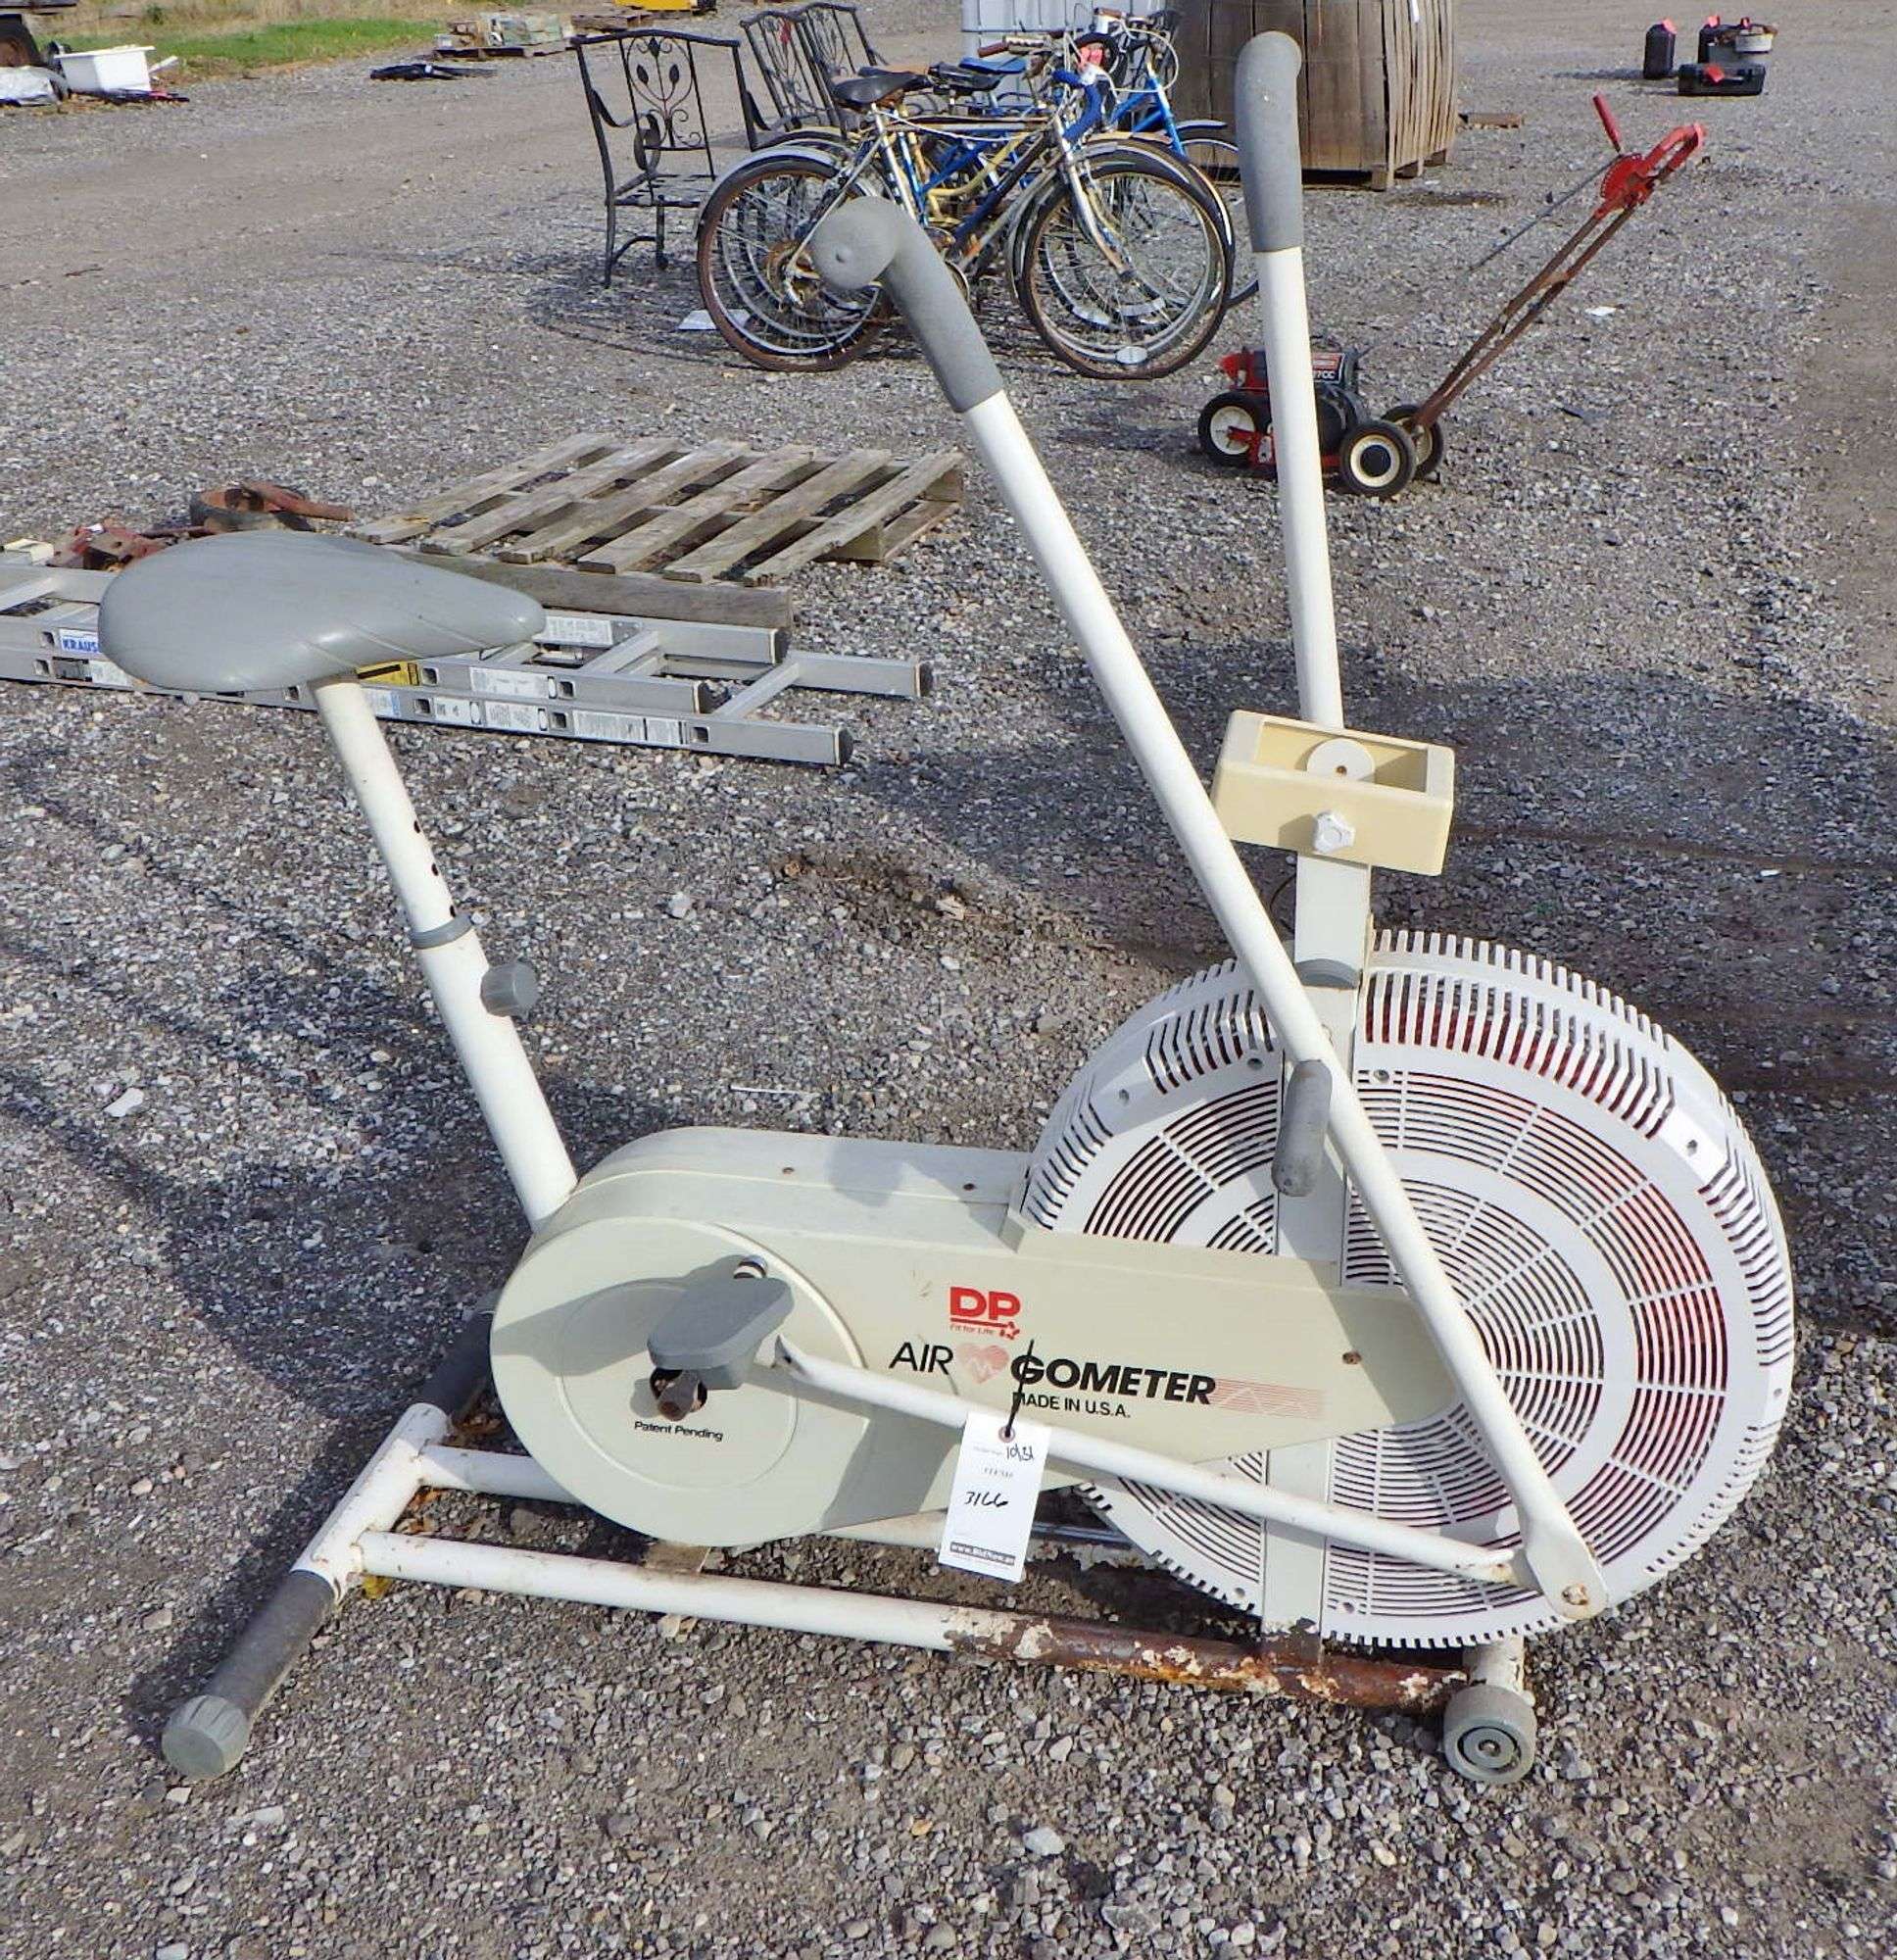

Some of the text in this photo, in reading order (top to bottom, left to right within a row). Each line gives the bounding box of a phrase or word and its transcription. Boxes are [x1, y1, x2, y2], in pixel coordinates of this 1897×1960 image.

[950, 1287, 1020, 1320] DP
[889, 1342, 1216, 1404] AIR GOMETER
[1013, 1392, 1131, 1418] MADE IN U.S.A.
[634, 1420, 723, 1443] Patent Pending
[963, 1491, 1009, 1507] 3166
